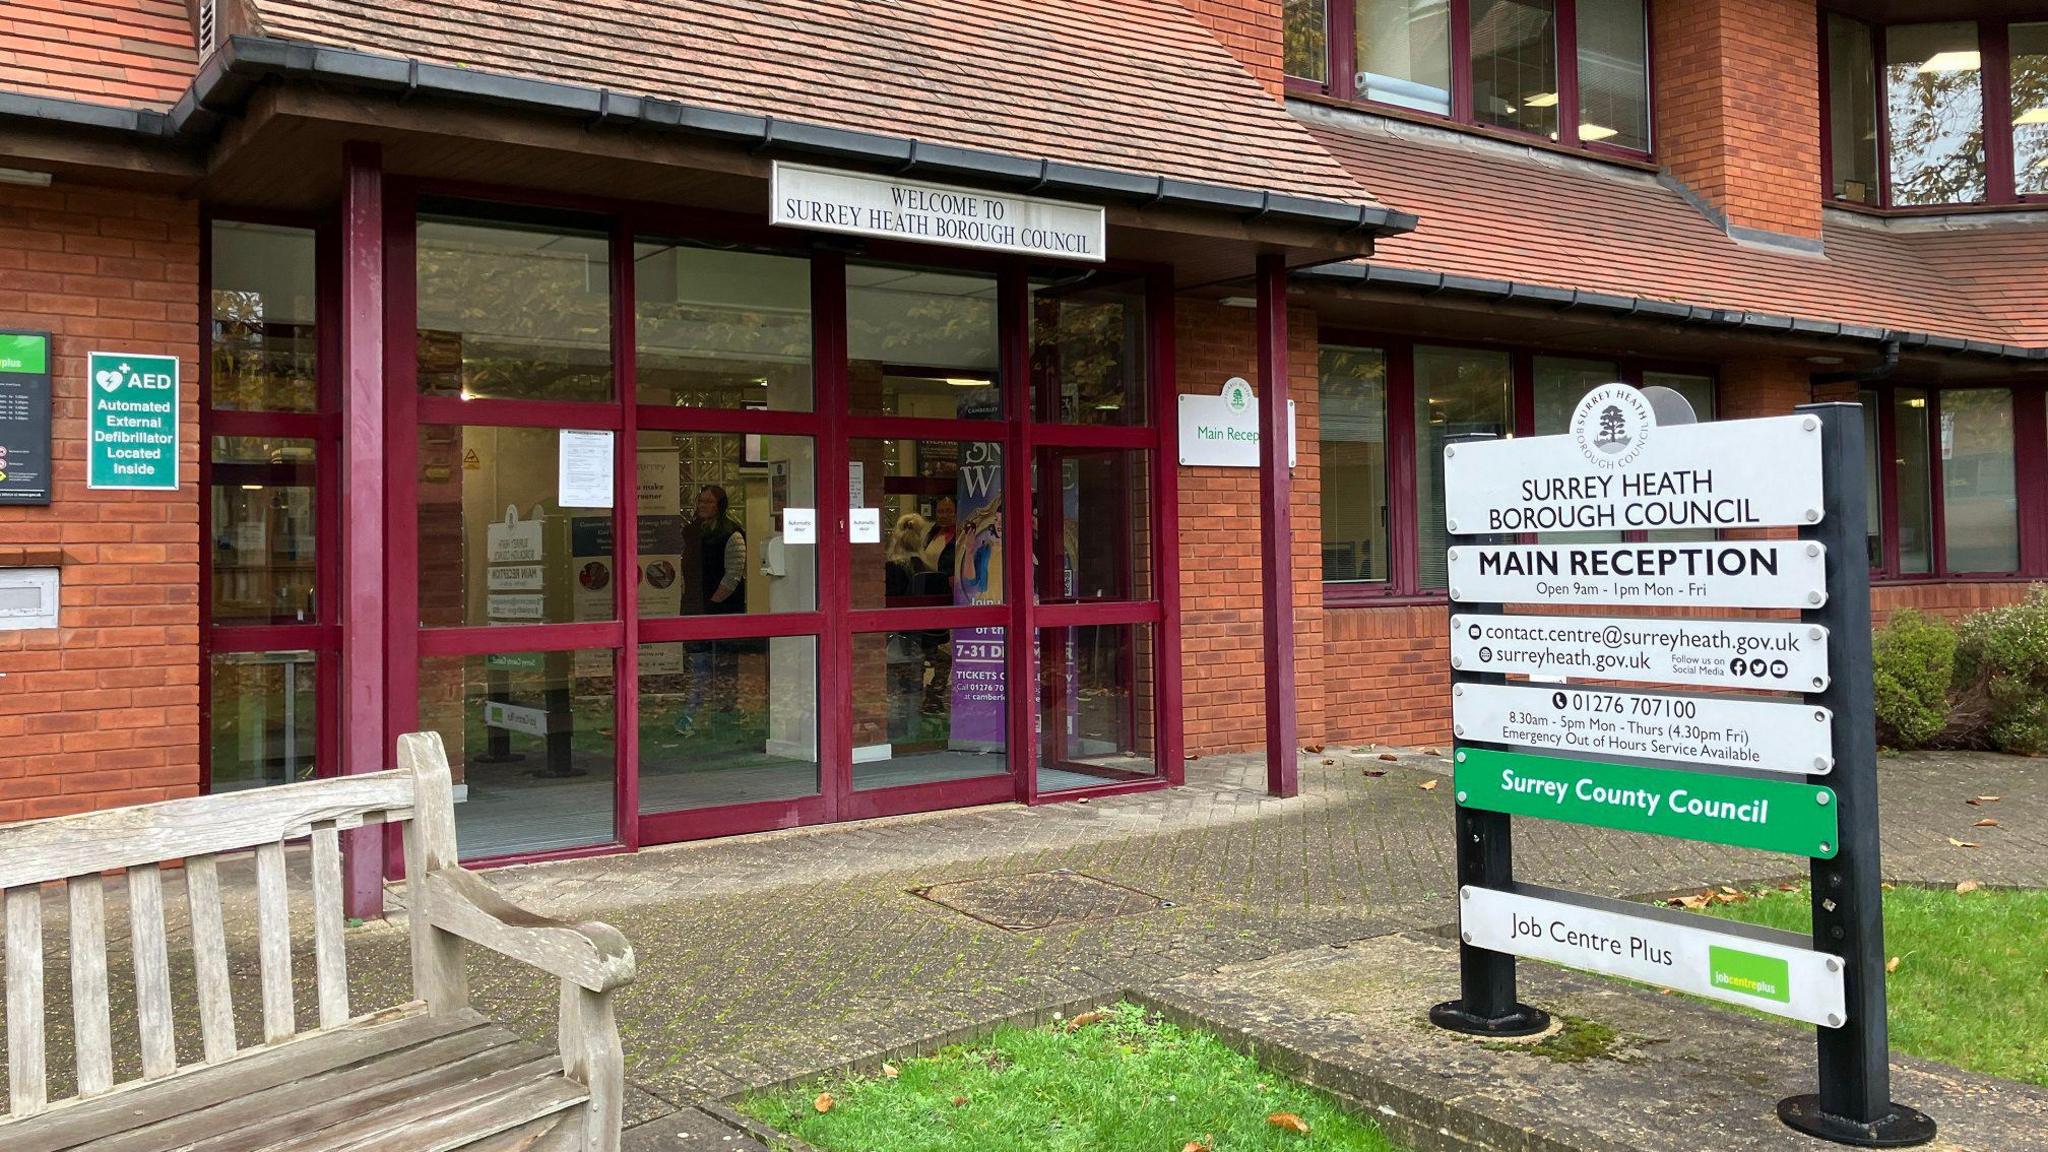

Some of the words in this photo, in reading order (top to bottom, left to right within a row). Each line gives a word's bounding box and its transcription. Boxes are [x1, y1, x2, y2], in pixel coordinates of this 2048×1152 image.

[891, 187, 977, 219] WELCOME
[983, 200, 1004, 221] TO
[786, 198, 861, 228] SURREY
[869, 208, 929, 236] HEATH
[936, 219, 1015, 246] BOROUGH
[1021, 228, 1091, 254] COUNCIL
[0, 359, 22, 368] plus
[127, 373, 171, 390] AED
[97, 399, 171, 413] Automated
[1577, 390, 1611, 426] SURREY
[1616, 390, 1647, 420] HEATH
[106, 415, 162, 428] External
[94, 430, 173, 444] Defibrillator
[1198, 426, 1223, 440] Main
[1227, 427, 1260, 444] Recep
[1577, 428, 1614, 470] BOROUGH
[1618, 422, 1649, 468] COUNCIL
[107, 447, 161, 459] Located
[114, 463, 155, 475] Inside
[1521, 475, 1614, 501] SURREY
[1622, 469, 1713, 497] HEATH
[1489, 504, 1615, 530] BOROUGH
[1625, 498, 1760, 526] COUNCIL
[1479, 550, 1559, 576] MAIN
[1570, 548, 1778, 576] RECEPTION
[1536, 581, 1570, 598] Open
[1573, 582, 1599, 595] 9am
[1613, 582, 1640, 599] 1pm
[1644, 582, 1674, 596] Mon
[1688, 582, 1707, 597] Fri
[991, 627, 1004, 635] th
[1486, 625, 1800, 655] contact.centre@surreyheath.gov.uk
[956, 645, 985, 657] 7-31
[1496, 647, 1651, 672] surreyheath.gov.uk
[1671, 654, 1699, 664] Follow
[956, 671, 997, 680] TICKETS
[1672, 664, 1697, 674] Social
[1699, 666, 1725, 676] Media
[1573, 693, 1624, 714] 01276
[1630, 697, 1696, 719] 707100
[1509, 711, 1548, 726] 8.30am
[1560, 716, 1585, 732] 5pm
[1589, 718, 1616, 732] Mon
[1627, 720, 1664, 737] Thurs
[1668, 724, 1721, 743] (4.30pm
[1726, 729, 1749, 747] Fri)
[1502, 726, 1561, 746] Emergency
[1565, 732, 1590, 746] Out
[1593, 735, 1605, 748] of
[1609, 736, 1647, 751] Hours
[1651, 740, 1697, 757] Service
[1700, 744, 1760, 762] Available
[1501, 769, 1569, 804] Surrey
[1575, 778, 1661, 816] County
[1669, 789, 1769, 824] Council
[1511, 912, 1542, 939] Job
[1550, 921, 1621, 955] Centre
[1630, 936, 1673, 966] Plus
[1715, 971, 1776, 994] jobcentreplus
